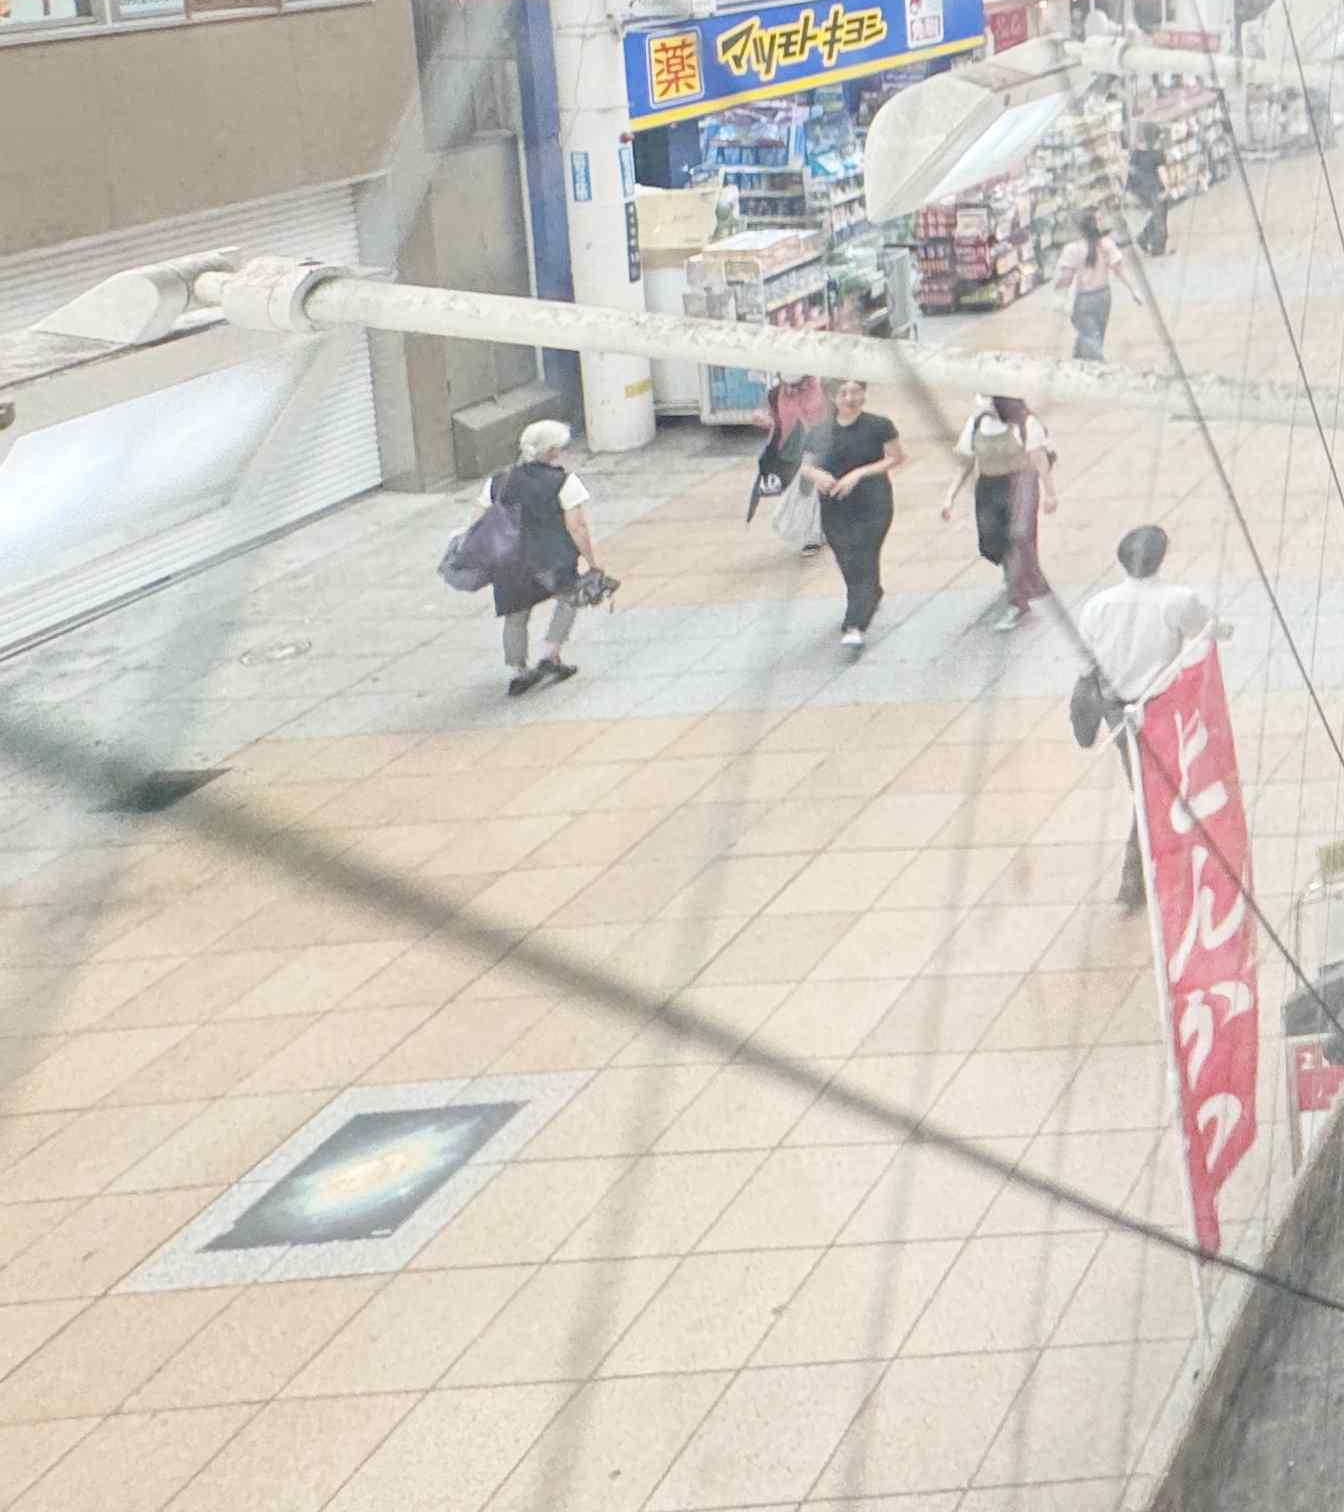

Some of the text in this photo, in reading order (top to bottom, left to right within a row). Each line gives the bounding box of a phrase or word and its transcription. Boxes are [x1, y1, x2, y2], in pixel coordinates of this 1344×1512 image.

[653, 38, 696, 97] 薬
[719, 8, 886, 77] マツモトキヨシ
